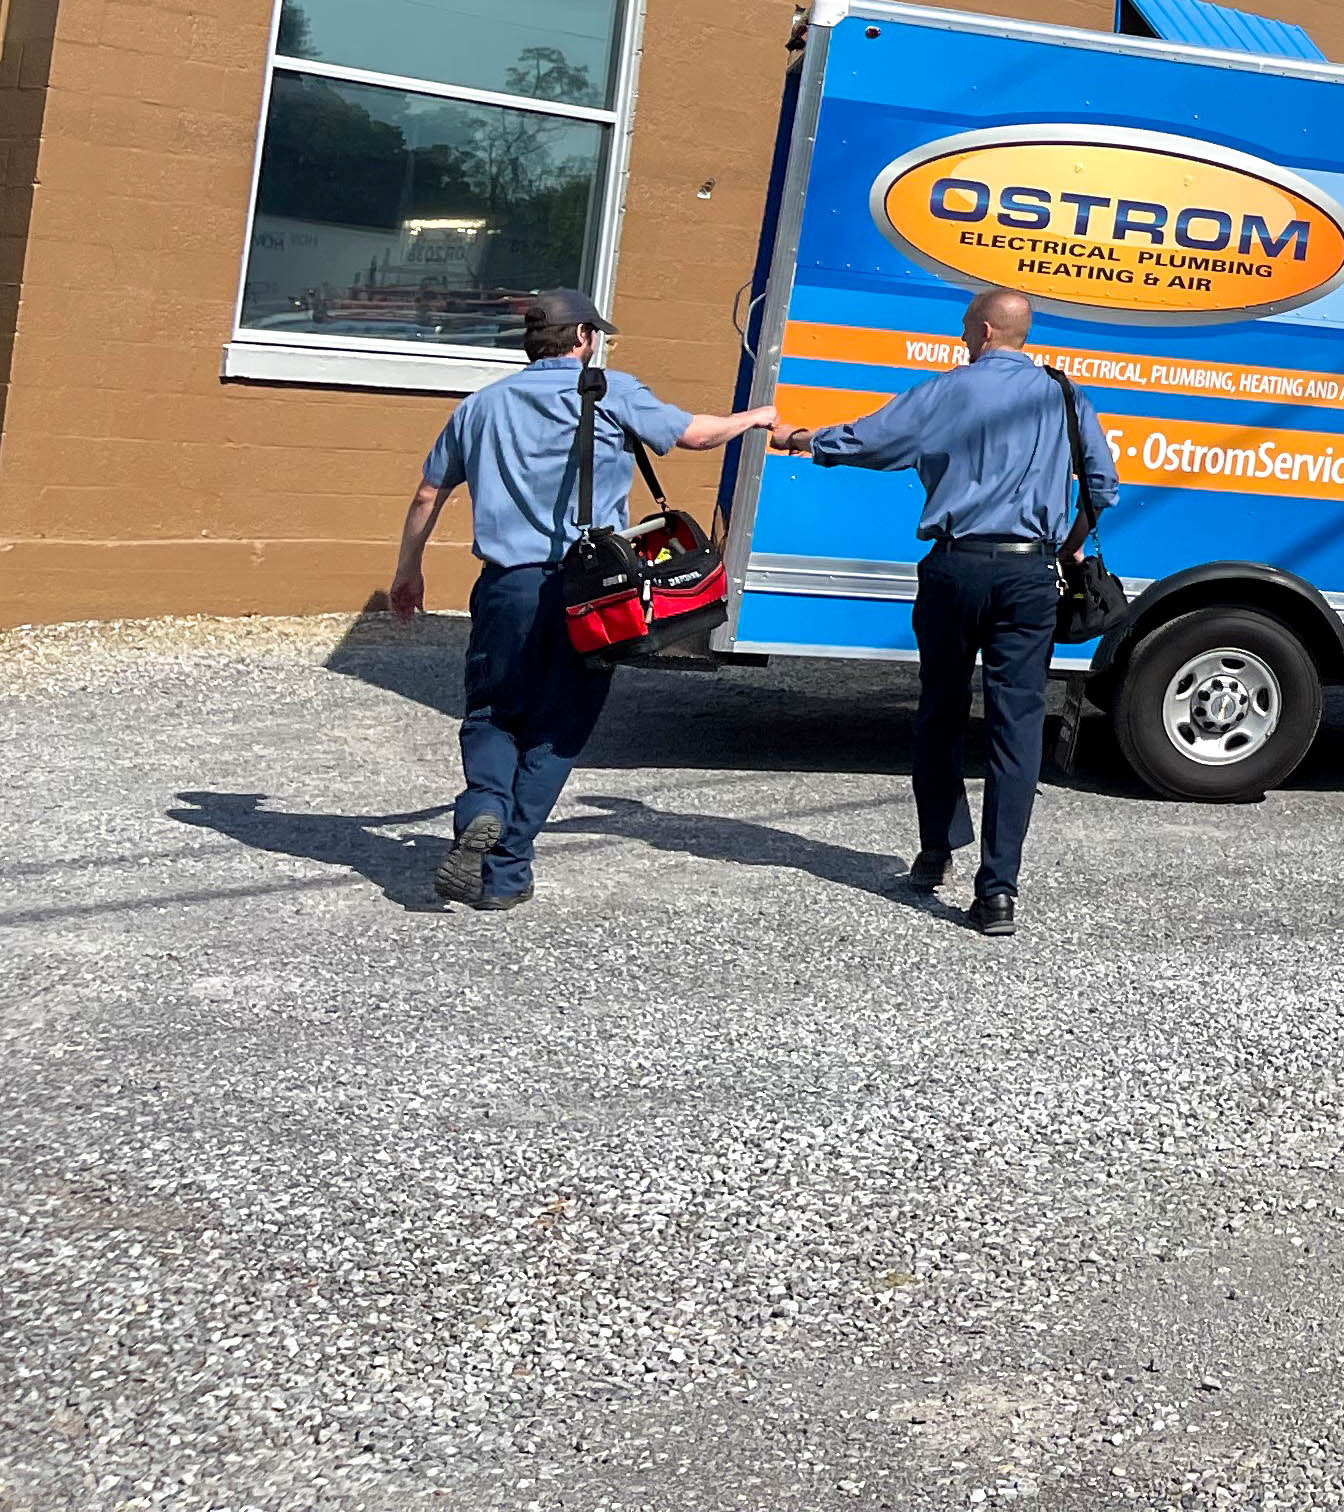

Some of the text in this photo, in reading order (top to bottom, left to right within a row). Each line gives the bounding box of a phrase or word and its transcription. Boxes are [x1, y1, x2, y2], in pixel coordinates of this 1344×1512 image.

[929, 177, 1311, 261] OSTROM
[959, 231, 1273, 278] ELECTRICAL PLUMBING
[1017, 259, 1212, 292] HEATING & AIR
[905, 340, 950, 364] YOUR
[1055, 355, 1147, 385] ELECTRICAL,
[1150, 365, 1236, 393] PLUMBING,
[1239, 374, 1303, 397] HEATING
[1304, 379, 1339, 400] AND
